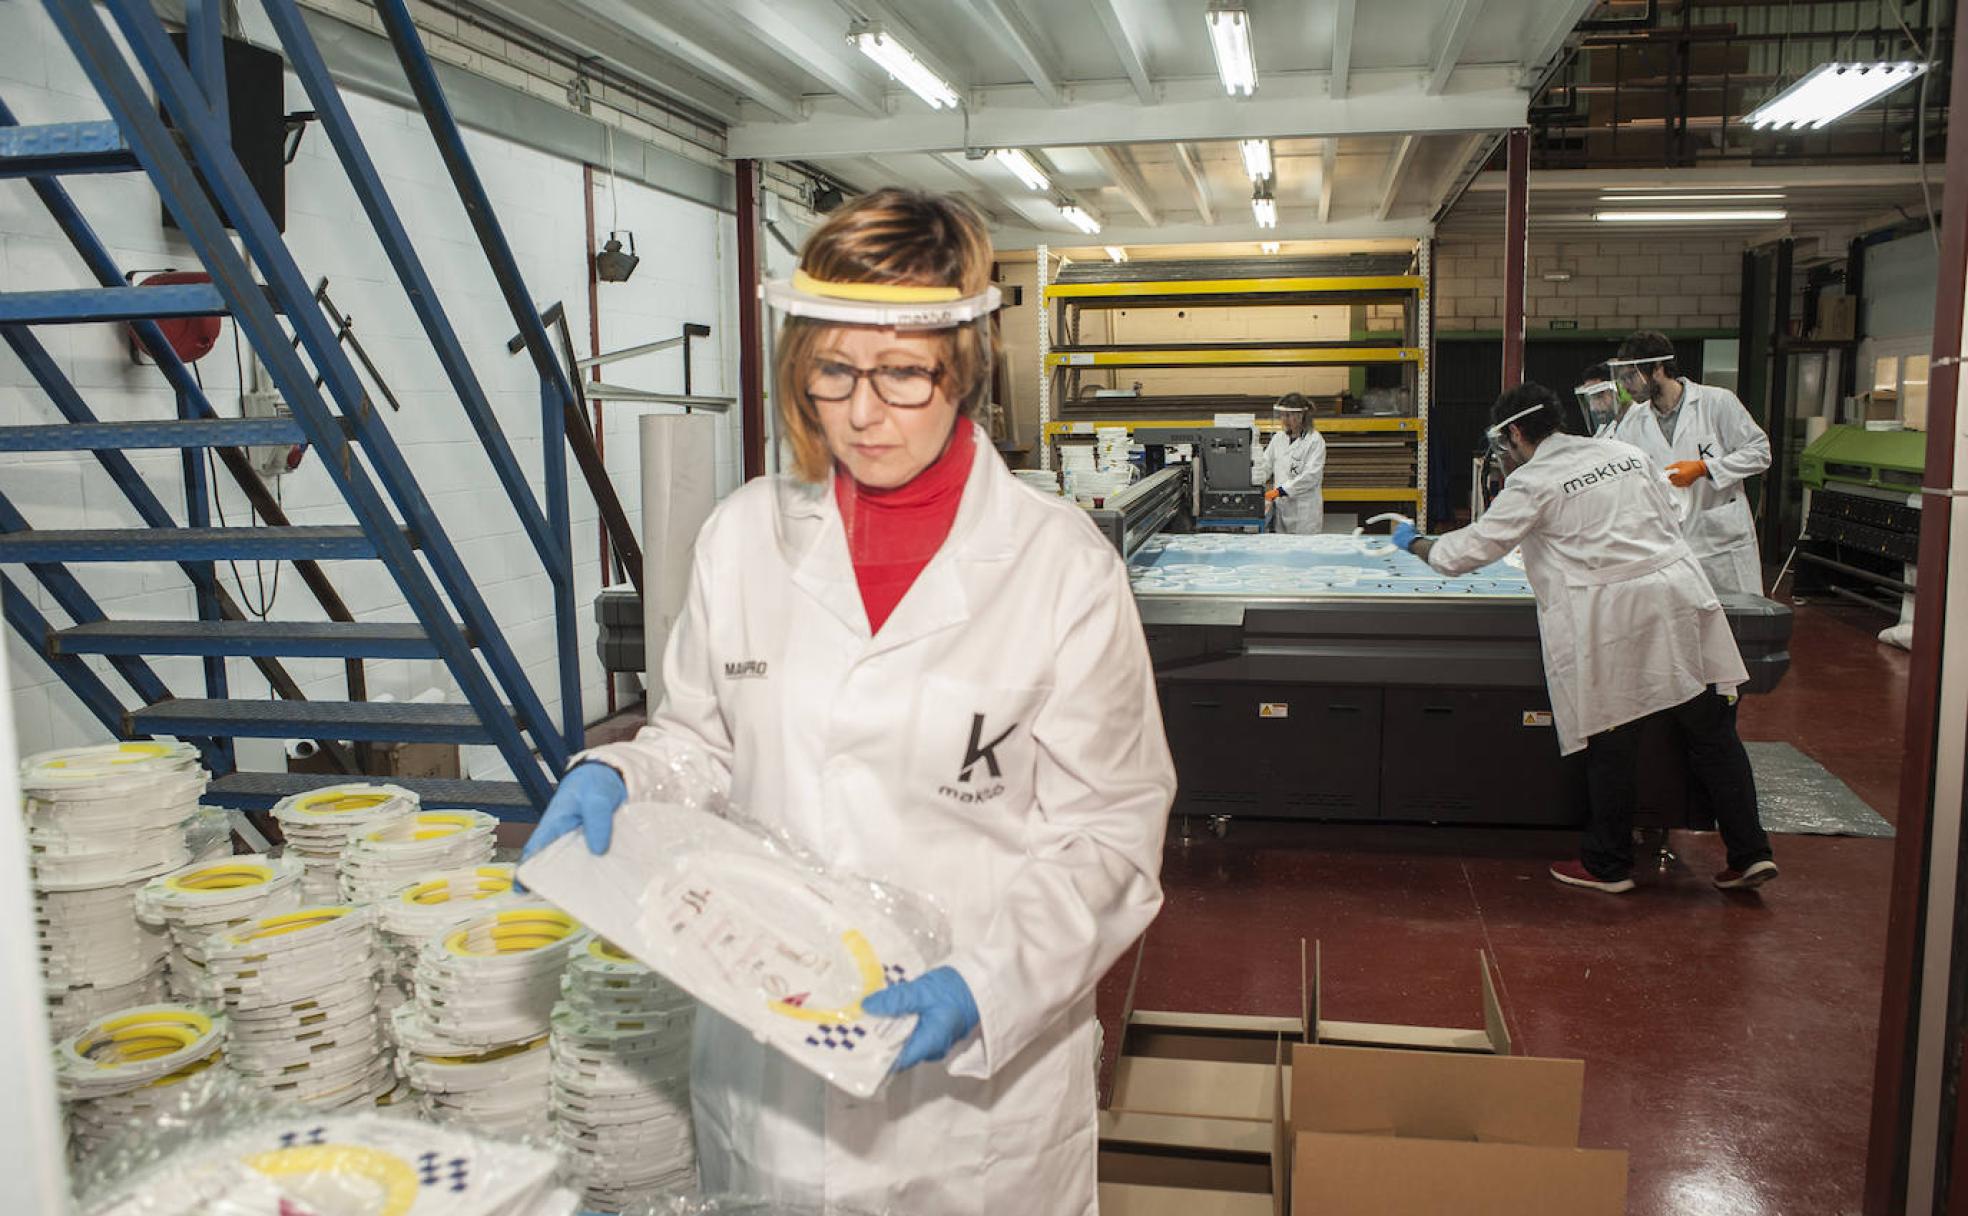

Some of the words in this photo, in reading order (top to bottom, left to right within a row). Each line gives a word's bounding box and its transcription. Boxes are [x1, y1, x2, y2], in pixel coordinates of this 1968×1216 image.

[1697, 443, 1714, 460] K
[1563, 456, 1643, 494] maktub
[958, 713, 1018, 782] K
